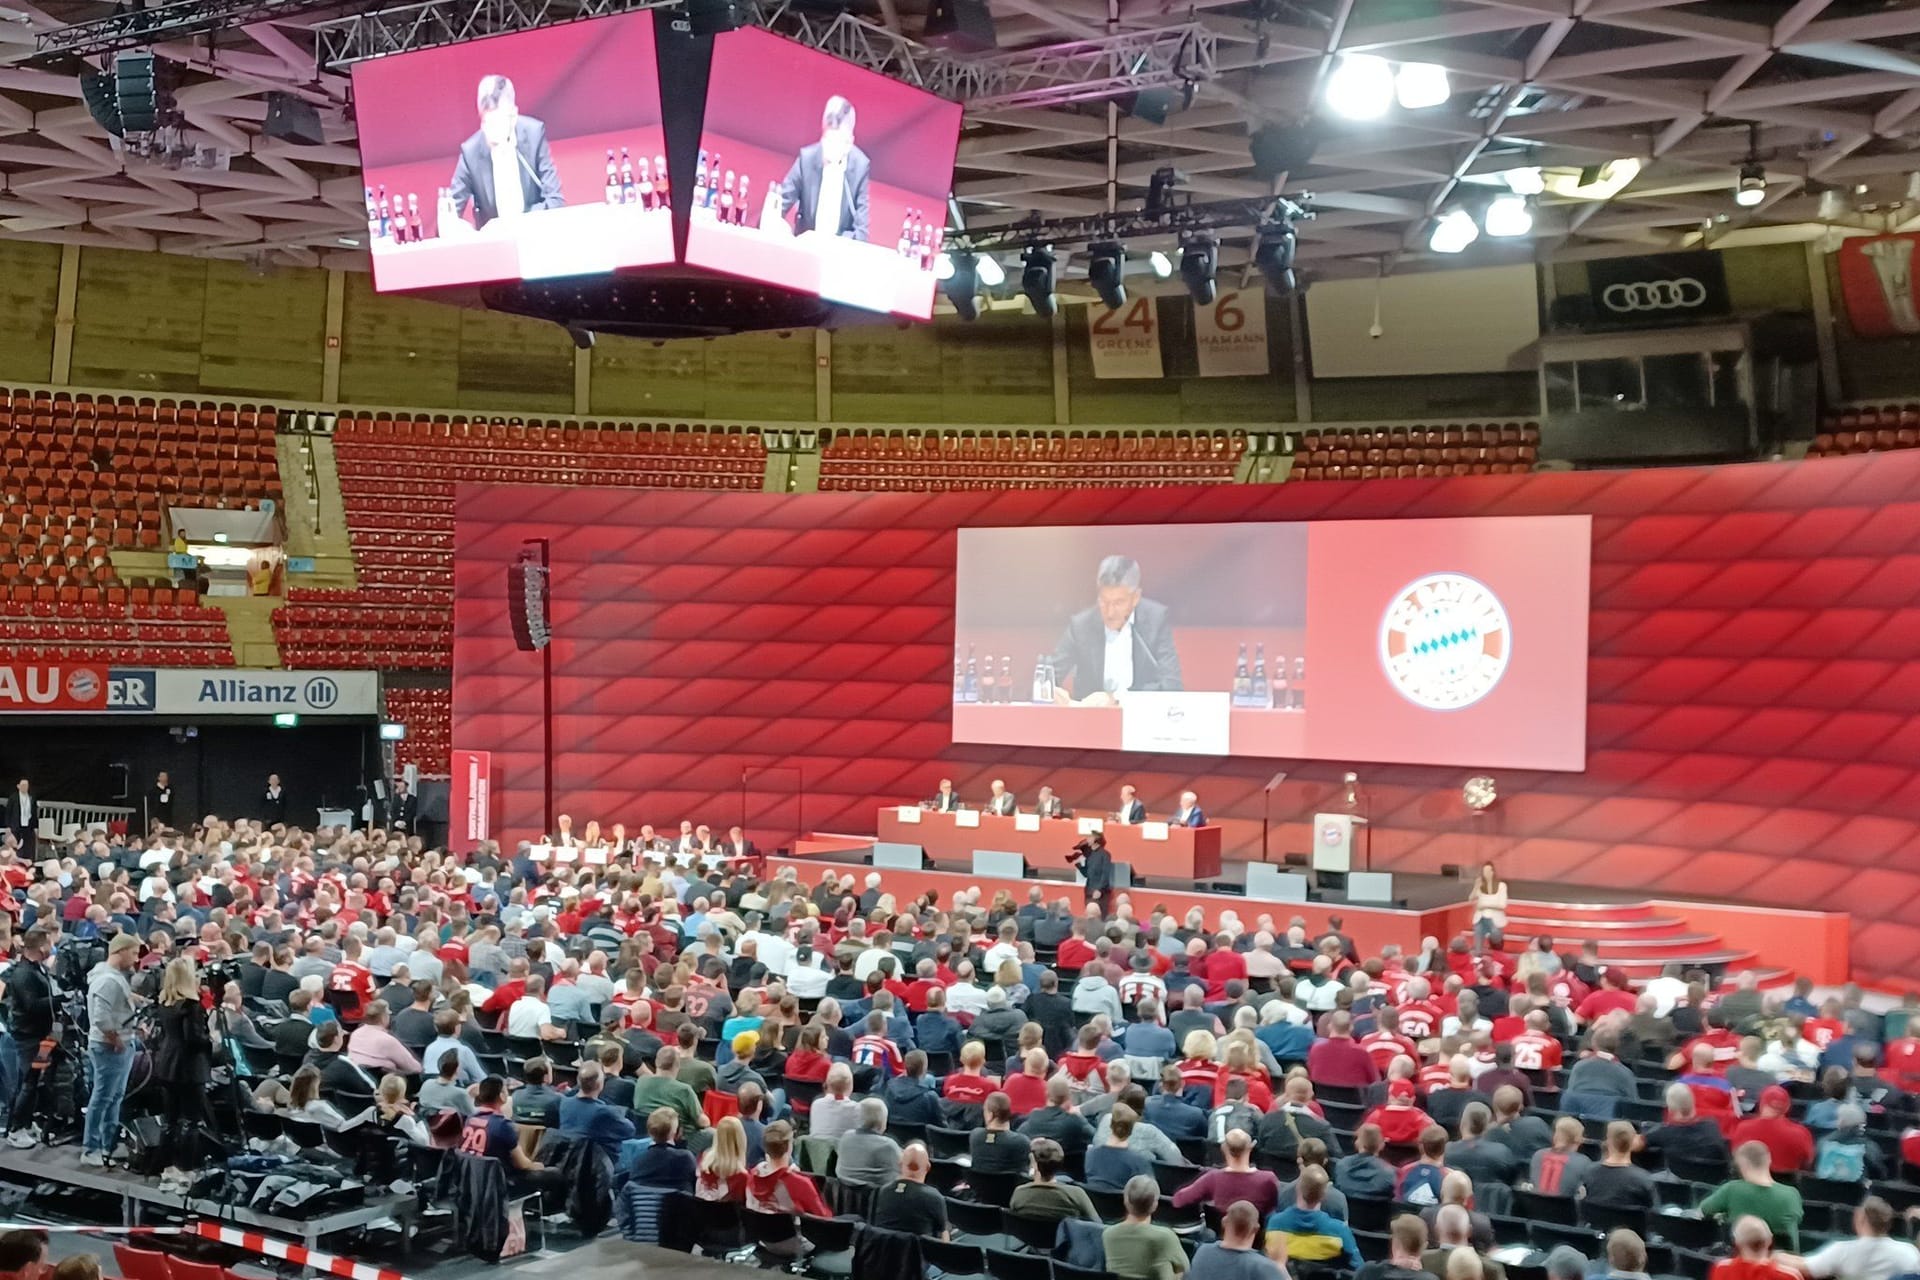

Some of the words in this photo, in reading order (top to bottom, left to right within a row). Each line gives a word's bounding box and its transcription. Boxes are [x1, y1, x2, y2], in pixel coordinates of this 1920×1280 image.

[1093, 297, 1153, 334] 24
[1214, 293, 1245, 332] 6
[199, 679, 297, 702] Allianz
